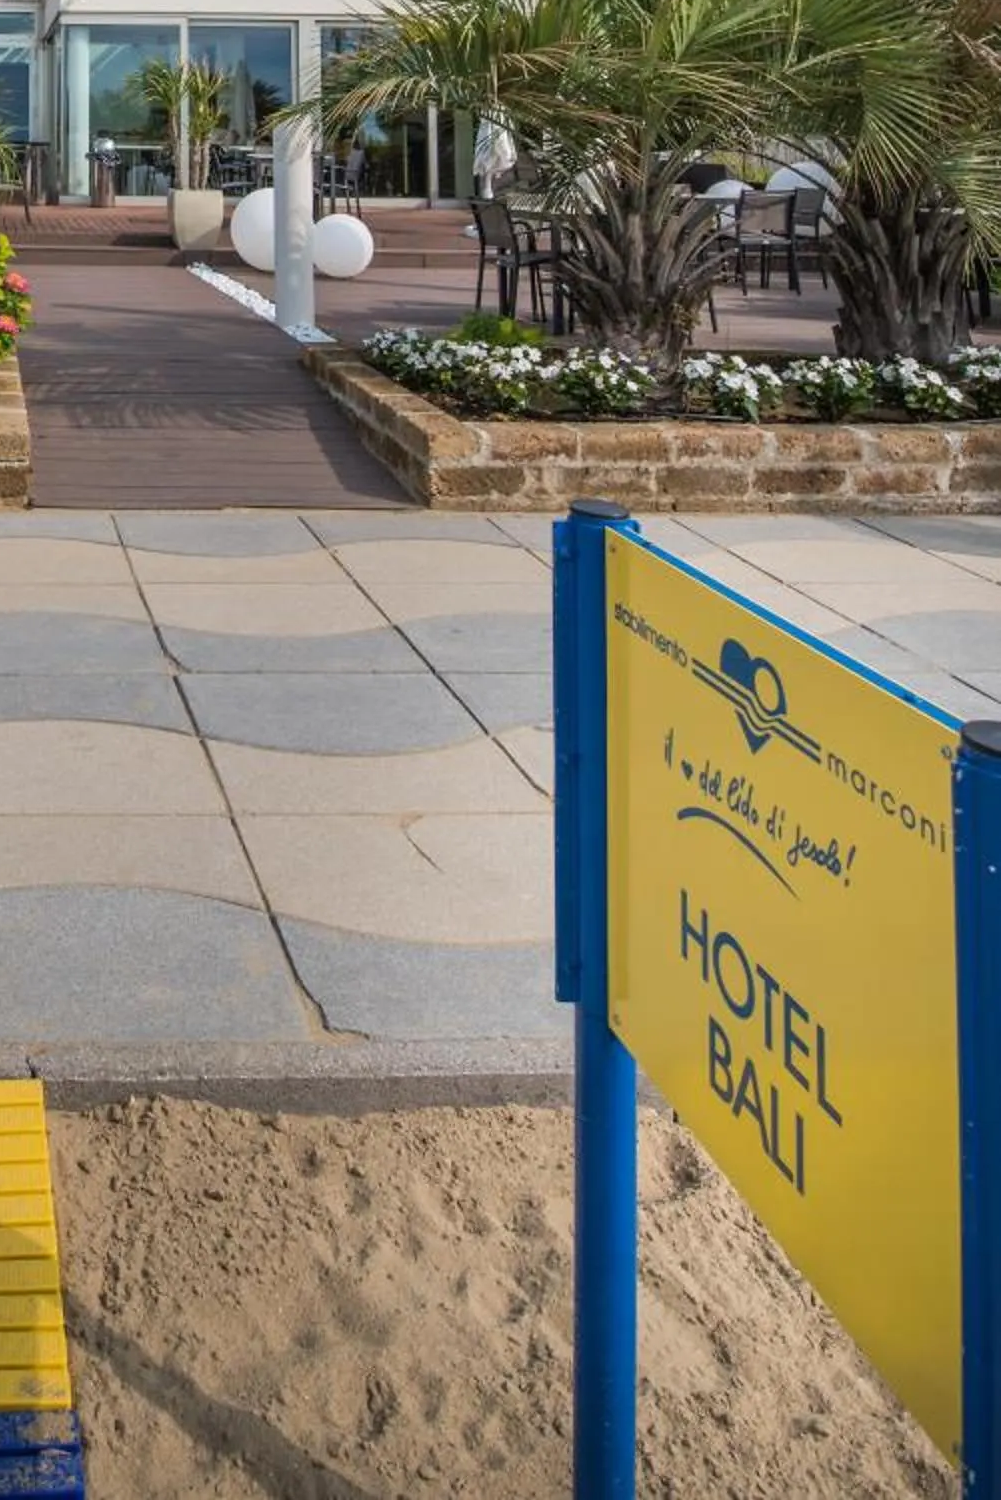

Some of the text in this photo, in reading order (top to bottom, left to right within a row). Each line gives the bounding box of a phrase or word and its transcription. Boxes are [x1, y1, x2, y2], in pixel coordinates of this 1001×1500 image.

[613, 602, 947, 853] stabilimento marconi
[664, 727, 674, 771] il
[699, 759, 722, 802] del
[766, 804, 786, 841] di
[680, 887, 843, 1127] HOTEL
[709, 1014, 805, 1196] BALI
